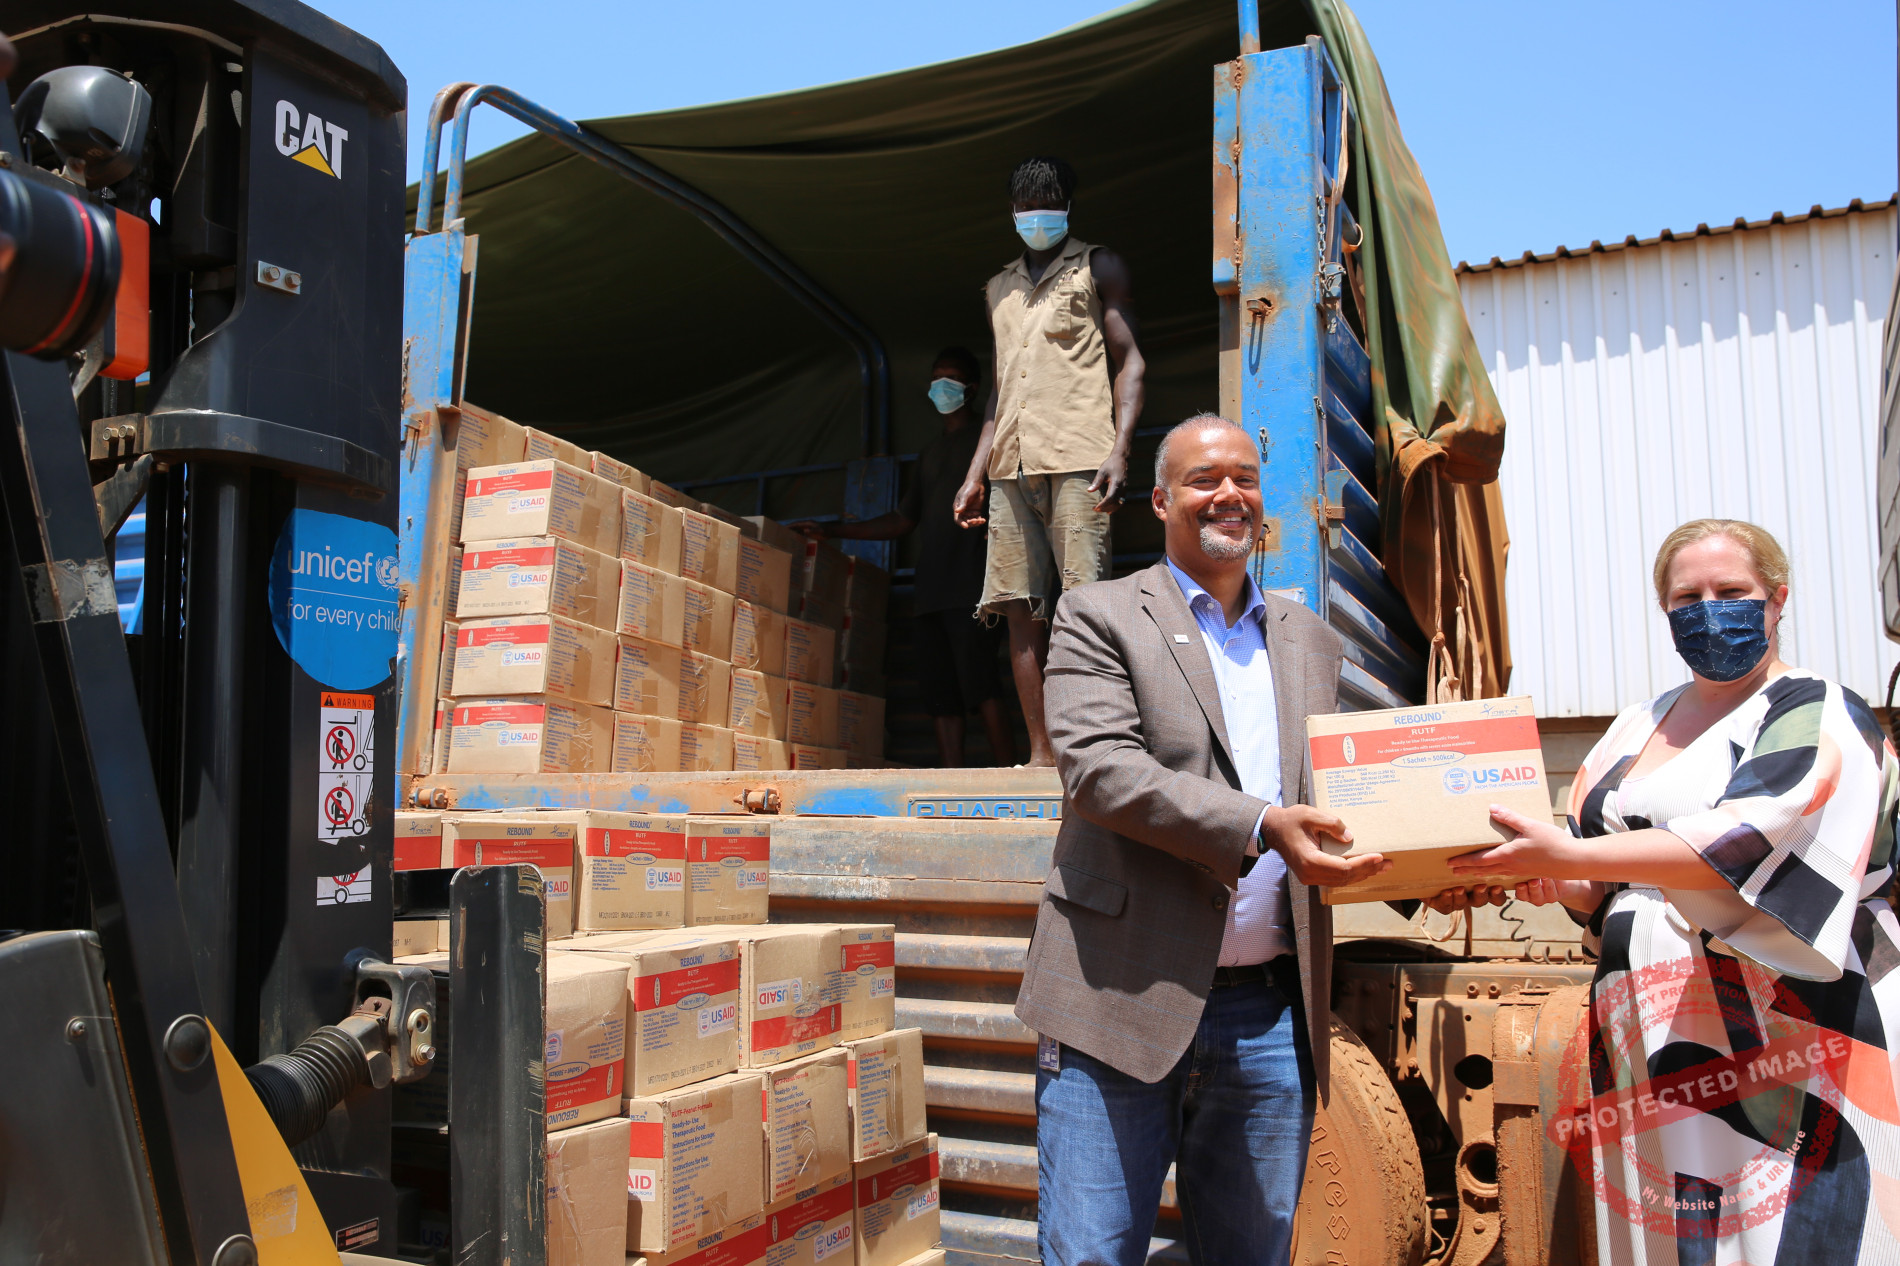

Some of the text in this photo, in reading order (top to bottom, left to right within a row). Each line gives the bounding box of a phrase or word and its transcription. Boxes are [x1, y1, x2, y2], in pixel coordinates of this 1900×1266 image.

[275, 100, 348, 179] CAT
[520, 498, 545, 506] USAID
[288, 545, 373, 584] unicef
[520, 574, 548, 582] USAID
[286, 597, 312, 620] for
[315, 606, 364, 631] every
[514, 652, 540, 660] USAID
[336, 698, 372, 708] WARNING
[1394, 712, 1442, 725] REBOUND
[510, 732, 538, 741] USAID
[1411, 726, 1436, 736] RUTF
[1472, 766, 1536, 783] USAID
[629, 820, 650, 829] REBOUND
[507, 827, 532, 836] REBOUND
[658, 872, 682, 882] USAID
[747, 872, 766, 882] USAID
[546, 880, 569, 892] SAID
[680, 956, 703, 967] REBOUND
[878, 979, 893, 990] USAID
[760, 990, 788, 1005] USAID
[712, 1006, 734, 1023] USAID
[555, 1099, 572, 1108] RUTF
[547, 1109, 579, 1125] REBOUND
[672, 1128, 696, 1138] Therapeutic
[796, 1186, 816, 1201] REBOUND
[918, 1191, 937, 1207] USAID
[698, 1232, 723, 1250] REBOUND
[827, 1226, 850, 1247] USAID
